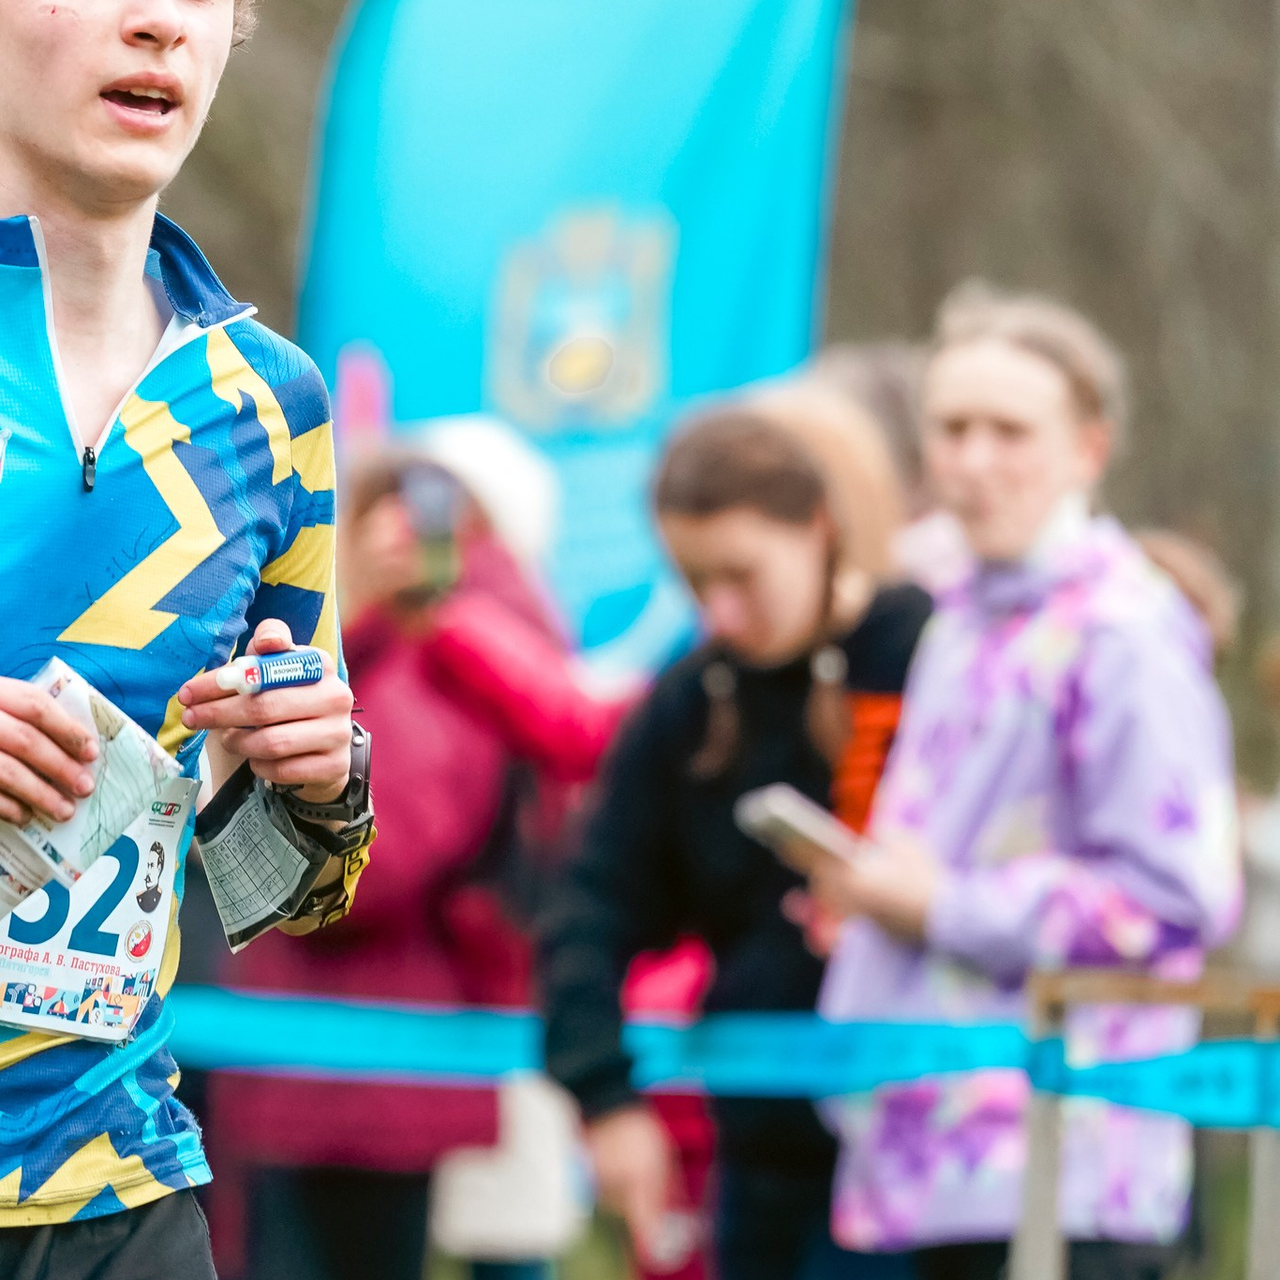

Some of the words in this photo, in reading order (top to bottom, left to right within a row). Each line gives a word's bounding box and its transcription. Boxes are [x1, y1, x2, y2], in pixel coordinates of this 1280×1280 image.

[42, 952, 52, 965] А.
[57, 955, 66, 967] В.
[70, 957, 121, 976] Пастухова
